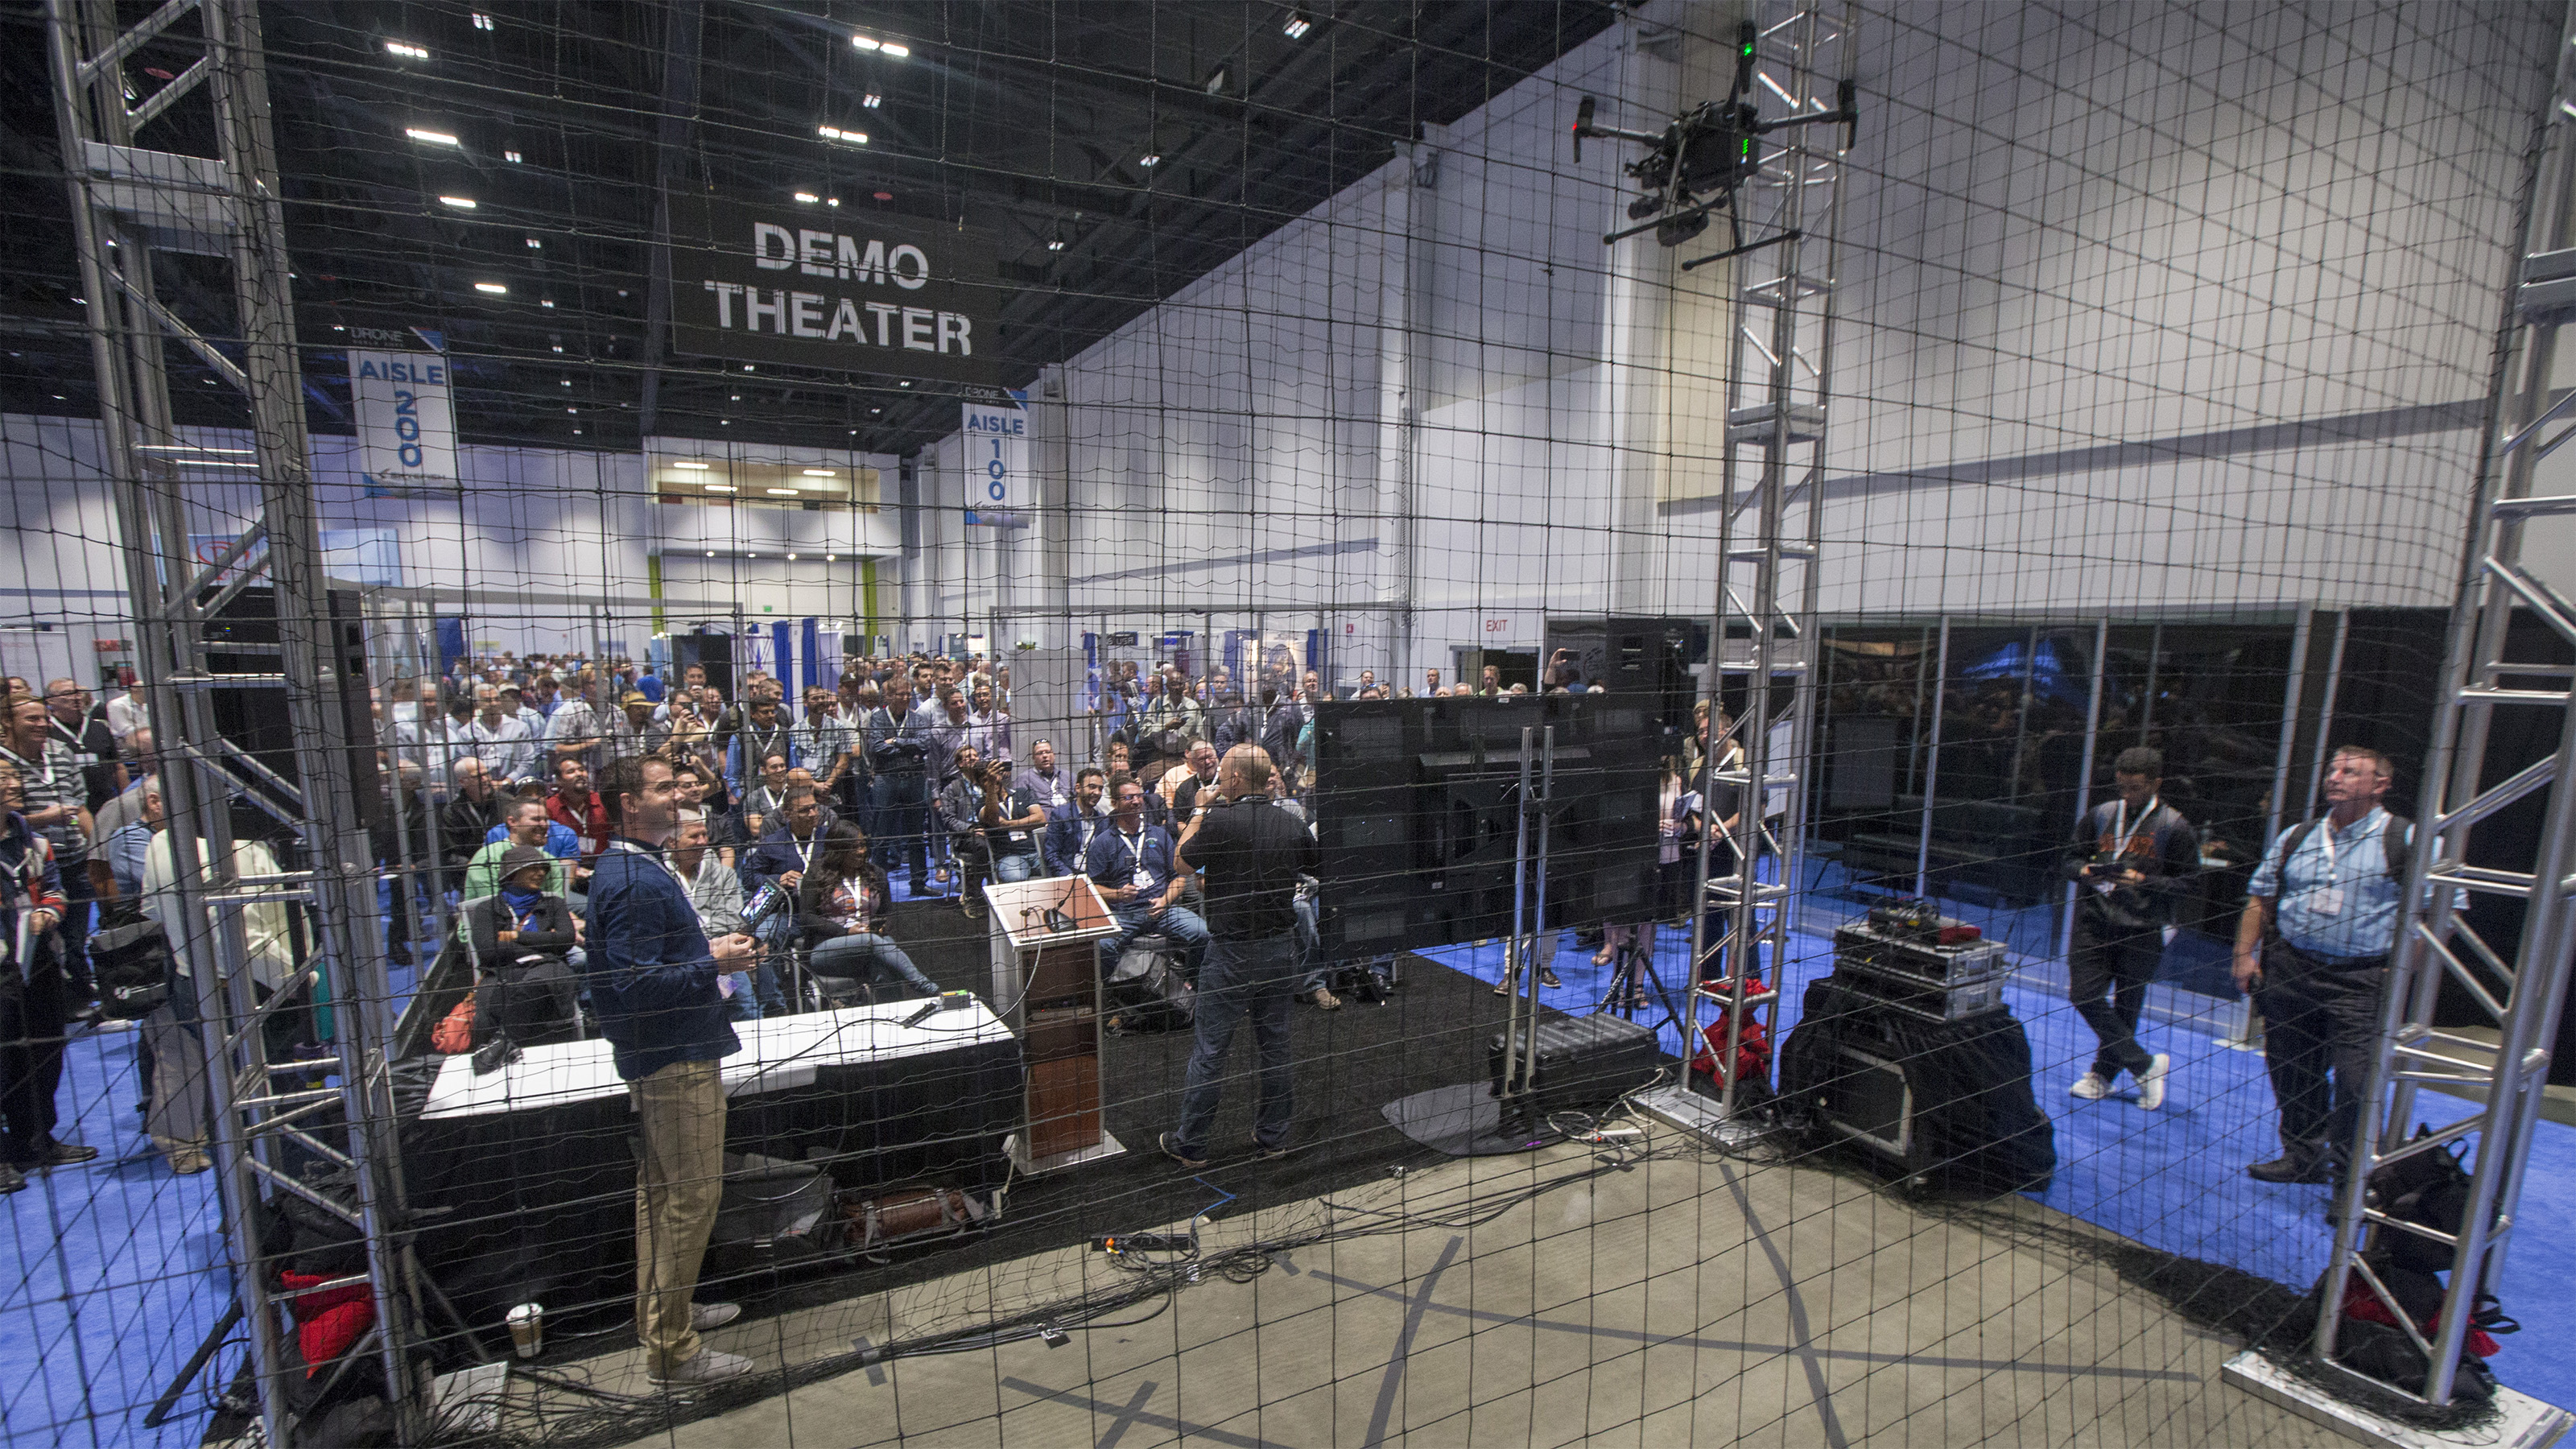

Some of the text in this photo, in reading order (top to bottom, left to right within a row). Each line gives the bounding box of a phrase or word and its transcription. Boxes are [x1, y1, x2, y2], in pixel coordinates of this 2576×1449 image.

[754, 221, 929, 290] DEMO
[704, 280, 972, 356] THEATER
[359, 360, 444, 385] AISLE
[394, 390, 423, 467] 200
[968, 414, 1024, 435] AISLE
[988, 439, 1005, 501] 100
[1486, 619, 1508, 632] EXIT
